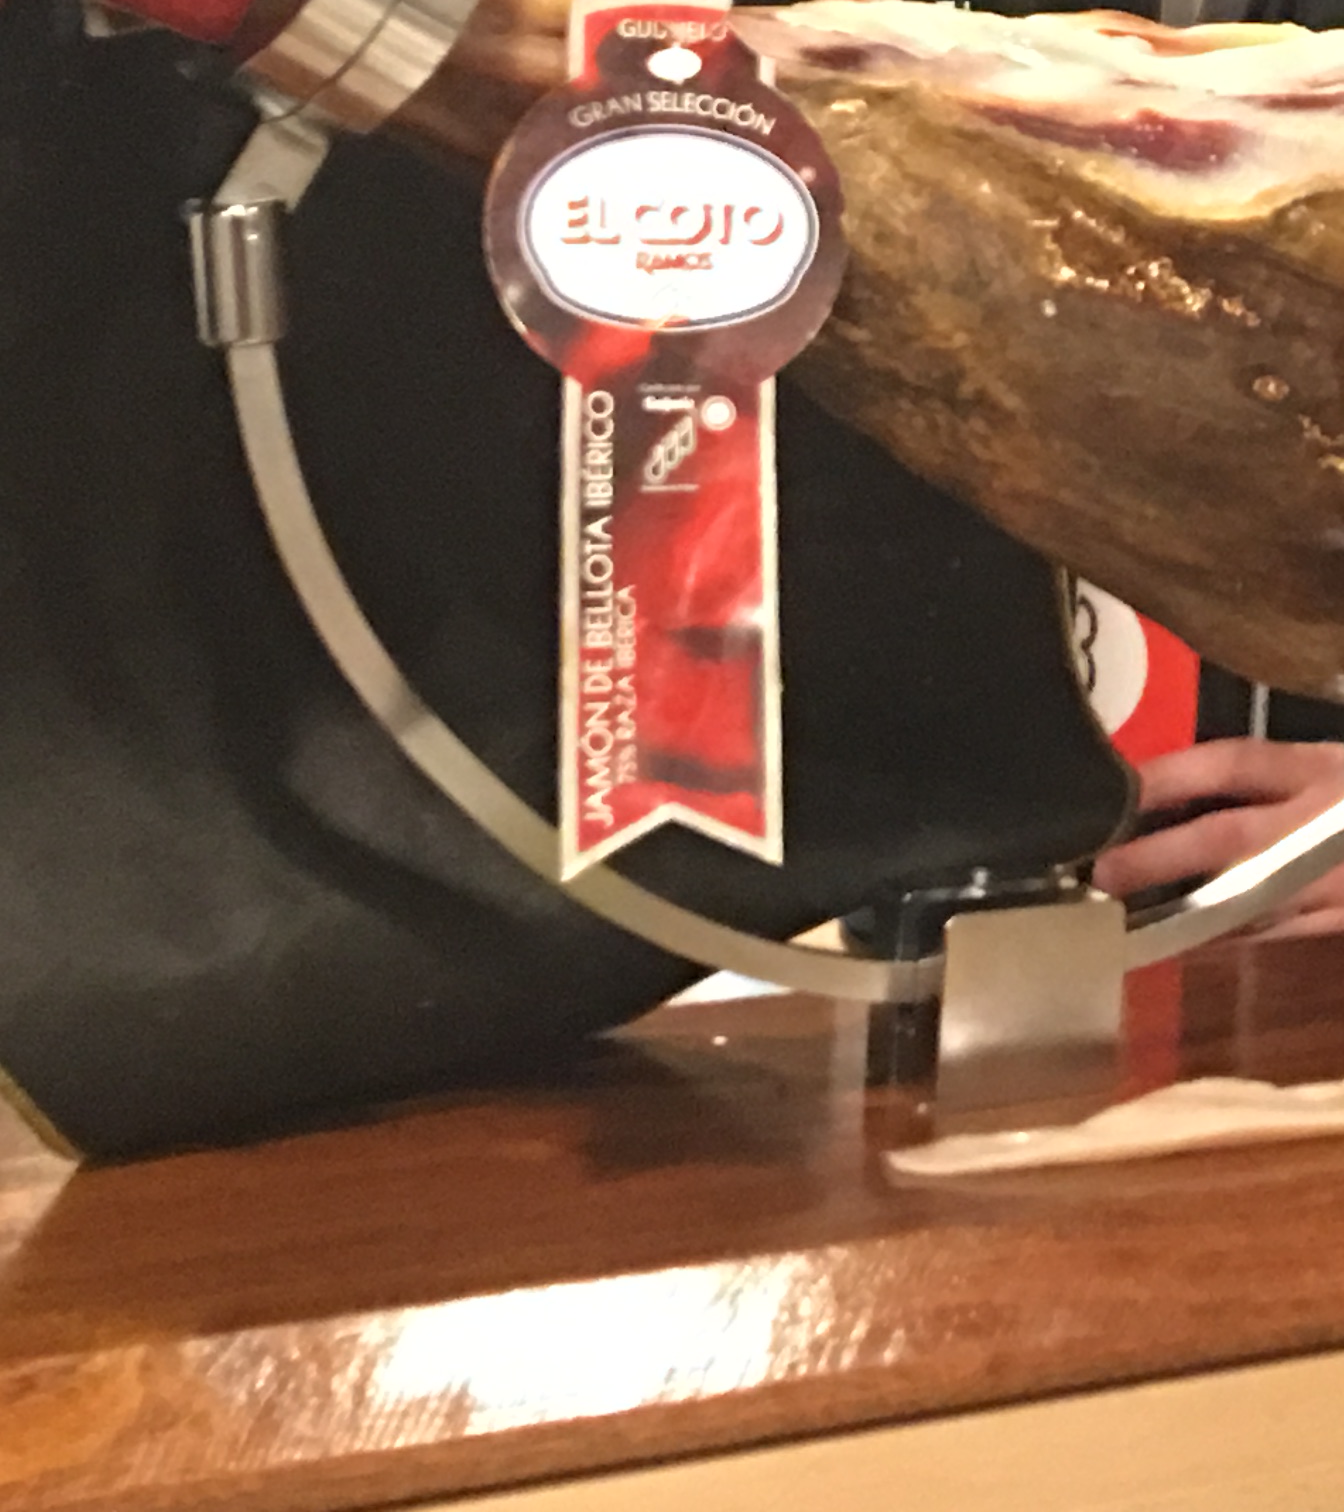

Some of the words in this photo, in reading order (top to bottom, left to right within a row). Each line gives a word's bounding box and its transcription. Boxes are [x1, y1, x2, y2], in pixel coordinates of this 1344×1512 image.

[568, 92, 643, 129] GRAN
[645, 90, 777, 136] SELECCIÓN
[560, 194, 622, 245] EL
[632, 197, 785, 246] COTO
[582, 390, 615, 508] IBÉRICO
[582, 514, 614, 649] BELLOTA
[582, 657, 614, 695] DE
[616, 673, 637, 741] RAZA
[578, 700, 615, 829] JAMÓN
